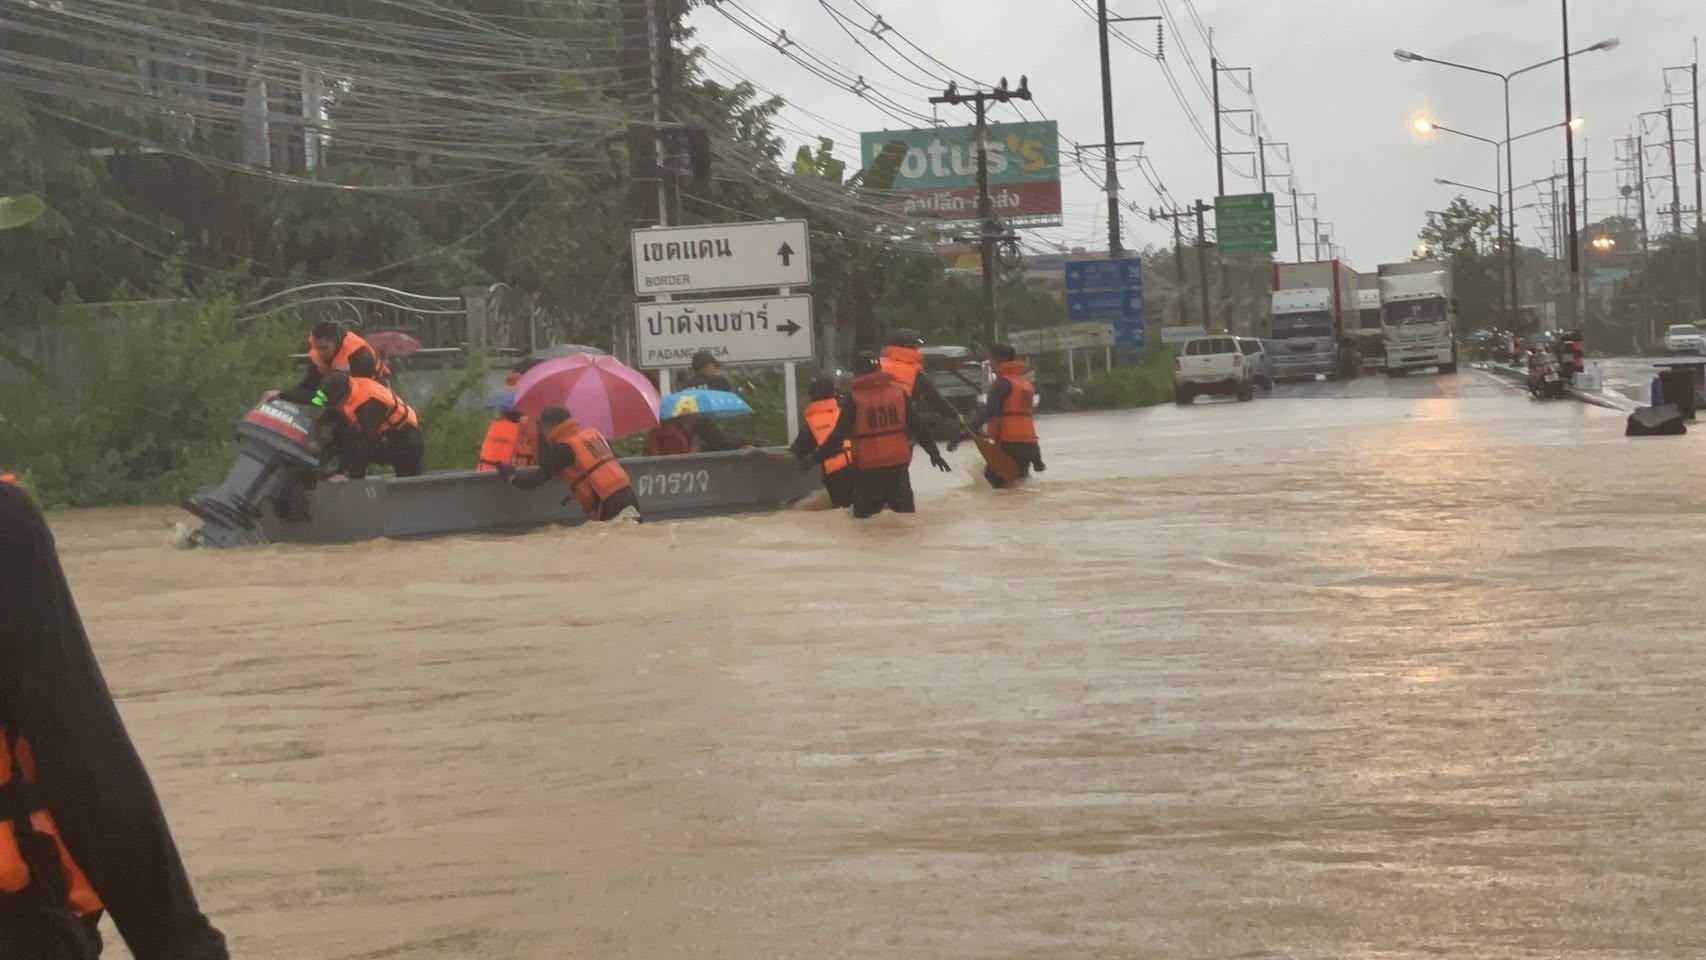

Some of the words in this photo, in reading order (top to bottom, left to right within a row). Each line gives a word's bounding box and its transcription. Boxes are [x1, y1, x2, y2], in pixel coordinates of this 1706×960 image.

[873, 134, 1046, 179] otus's
[643, 237, 733, 262] เขตแดน
[645, 274, 691, 287] BORDER
[647, 302, 769, 336] ปาดังเบซาร์
